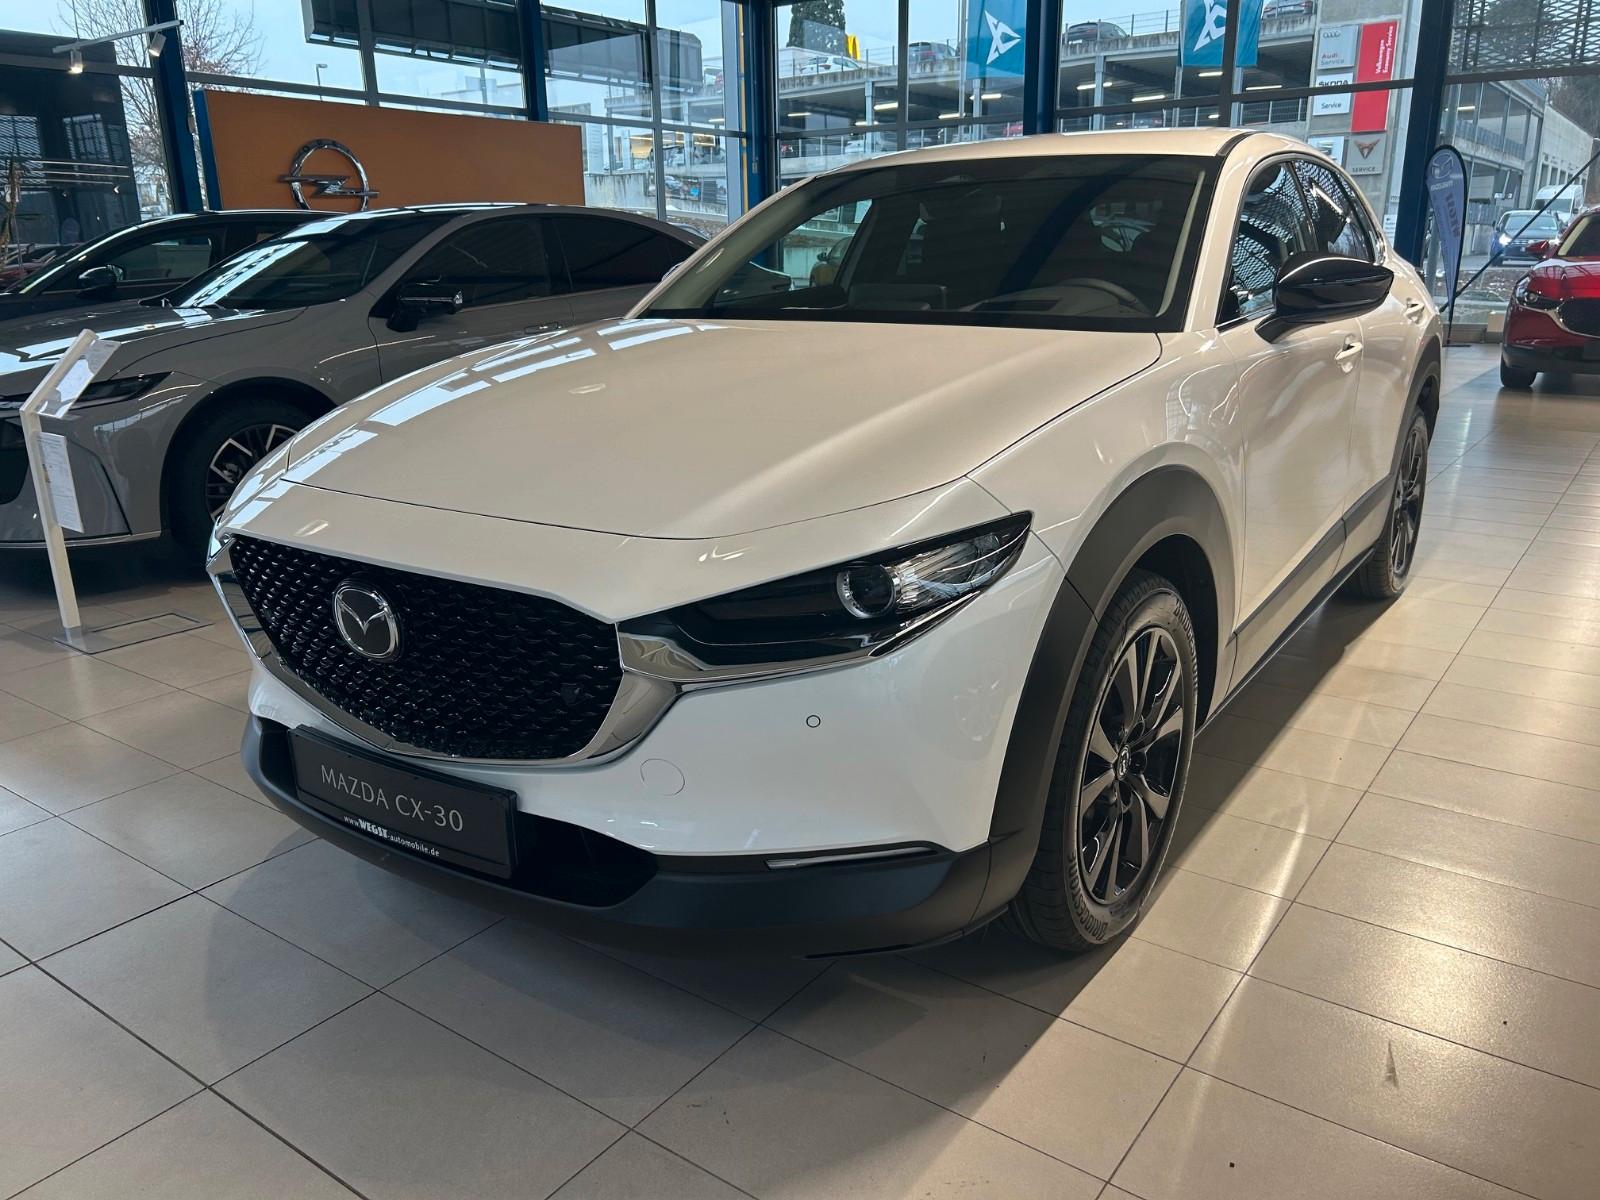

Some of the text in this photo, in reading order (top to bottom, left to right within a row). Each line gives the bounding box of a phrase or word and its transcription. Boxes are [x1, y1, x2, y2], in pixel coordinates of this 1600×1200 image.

[1321, 101, 1342, 110] Service
[321, 764, 464, 832] MAZDA CX-30
